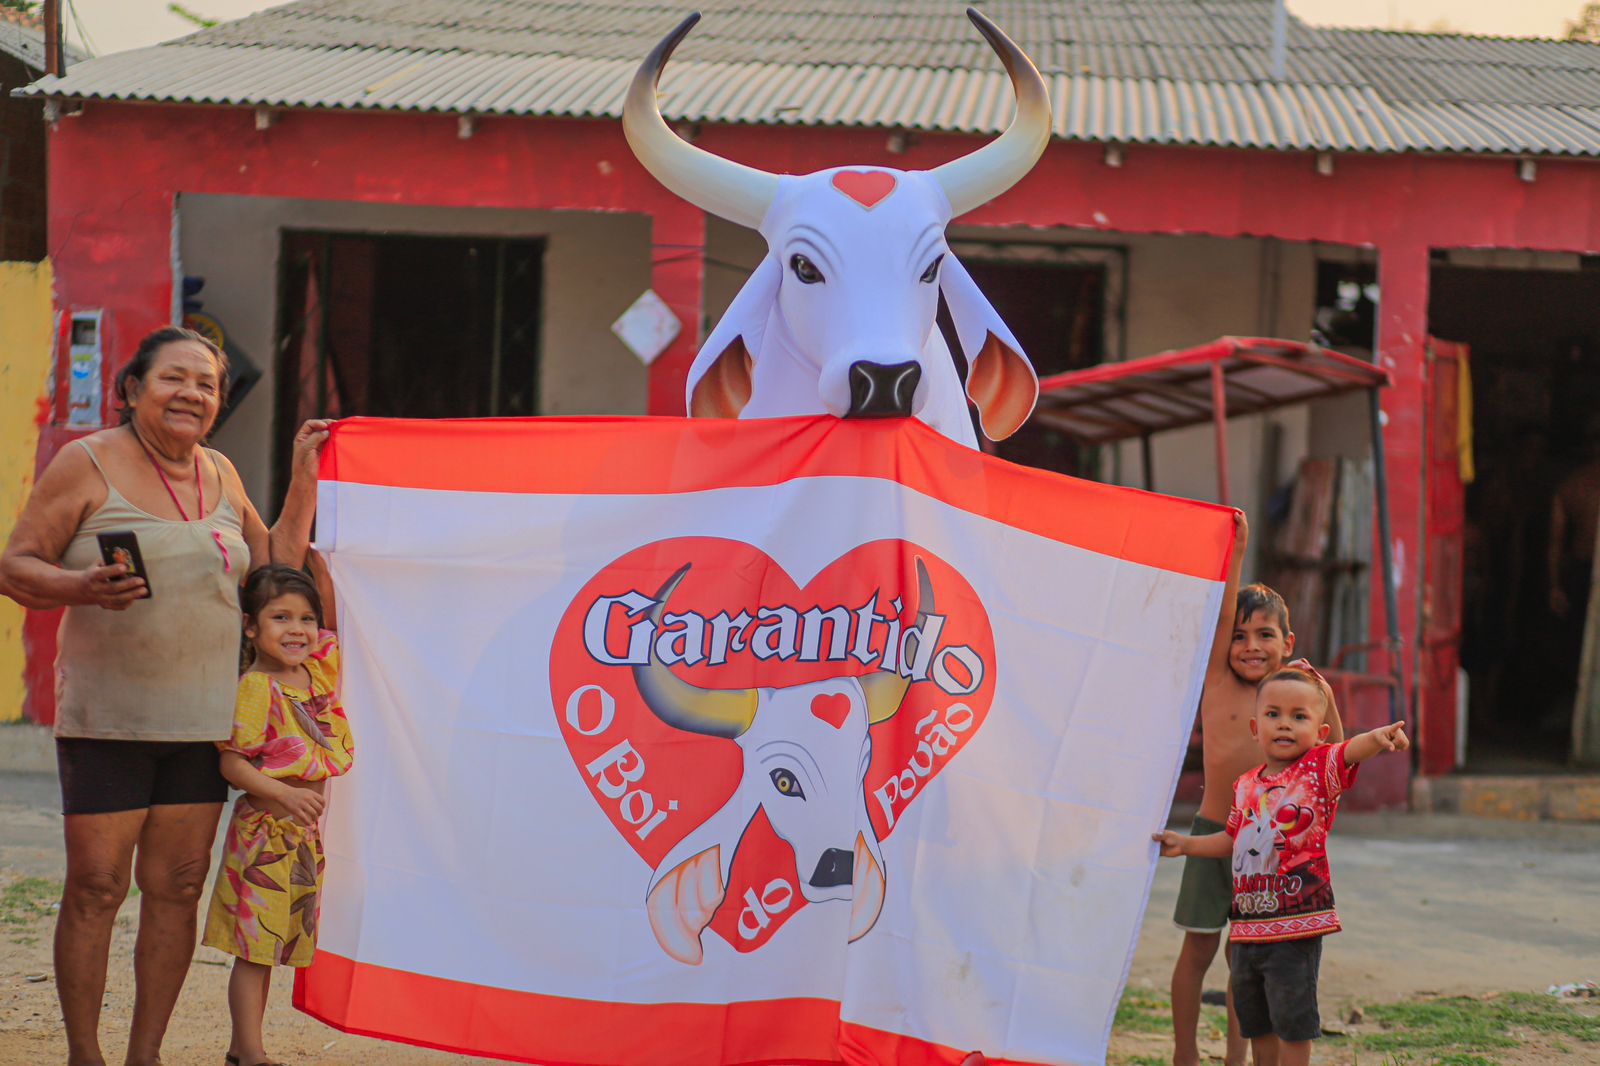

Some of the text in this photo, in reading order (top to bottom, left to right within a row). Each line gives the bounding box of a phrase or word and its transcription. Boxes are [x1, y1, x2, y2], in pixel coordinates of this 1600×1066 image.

[583, 588, 985, 695] Garantido
[566, 684, 616, 736] O
[585, 738, 679, 841] Boi
[738, 878, 793, 940] do
[1236, 892, 1279, 915] 2023
